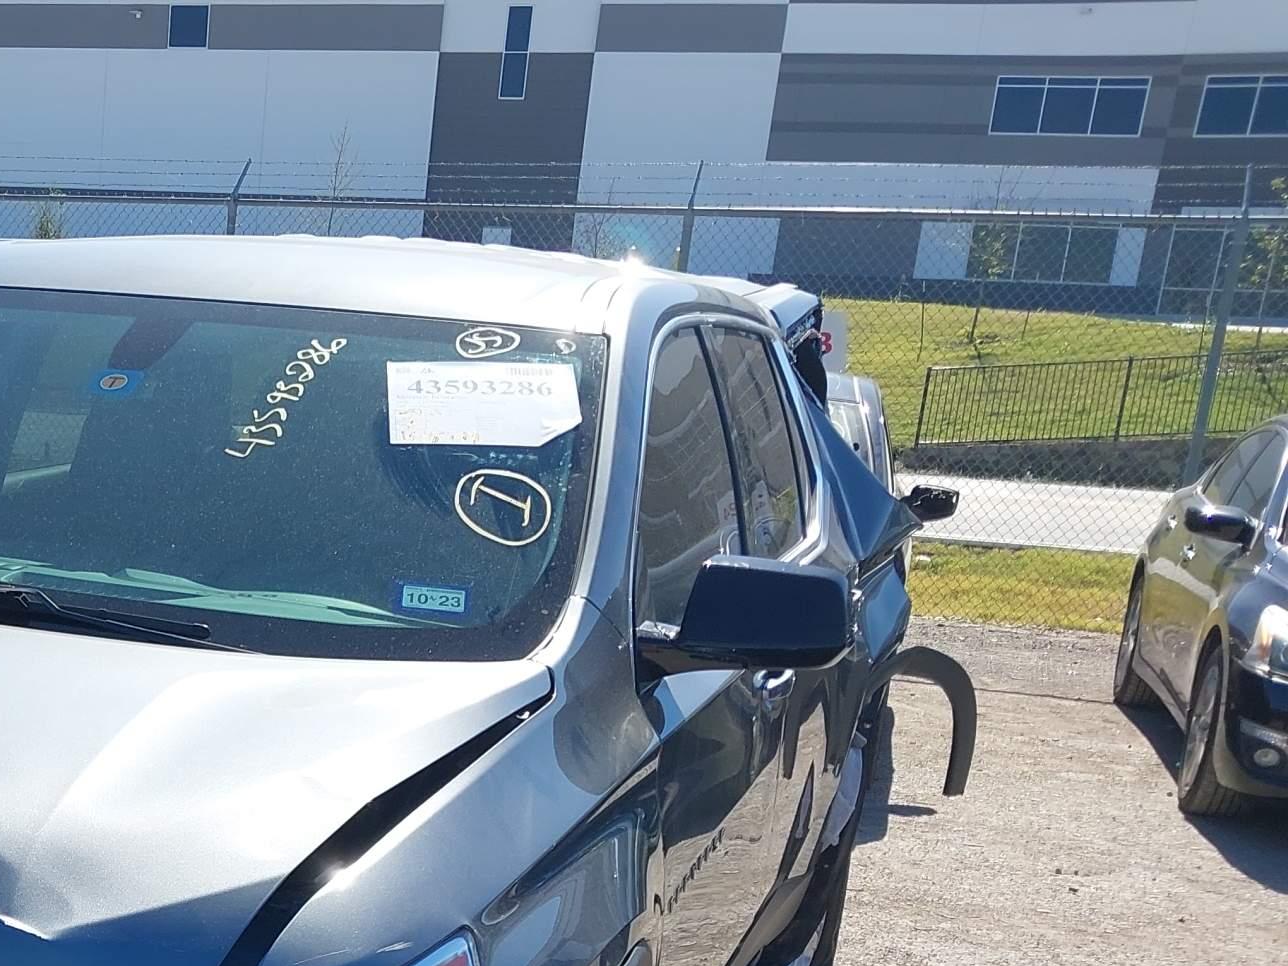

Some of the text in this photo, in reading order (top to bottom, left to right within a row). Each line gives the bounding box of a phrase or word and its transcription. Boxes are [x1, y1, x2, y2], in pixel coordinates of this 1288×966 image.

[407, 379, 553, 397] 43593286
[407, 592, 461, 608] 10 23
